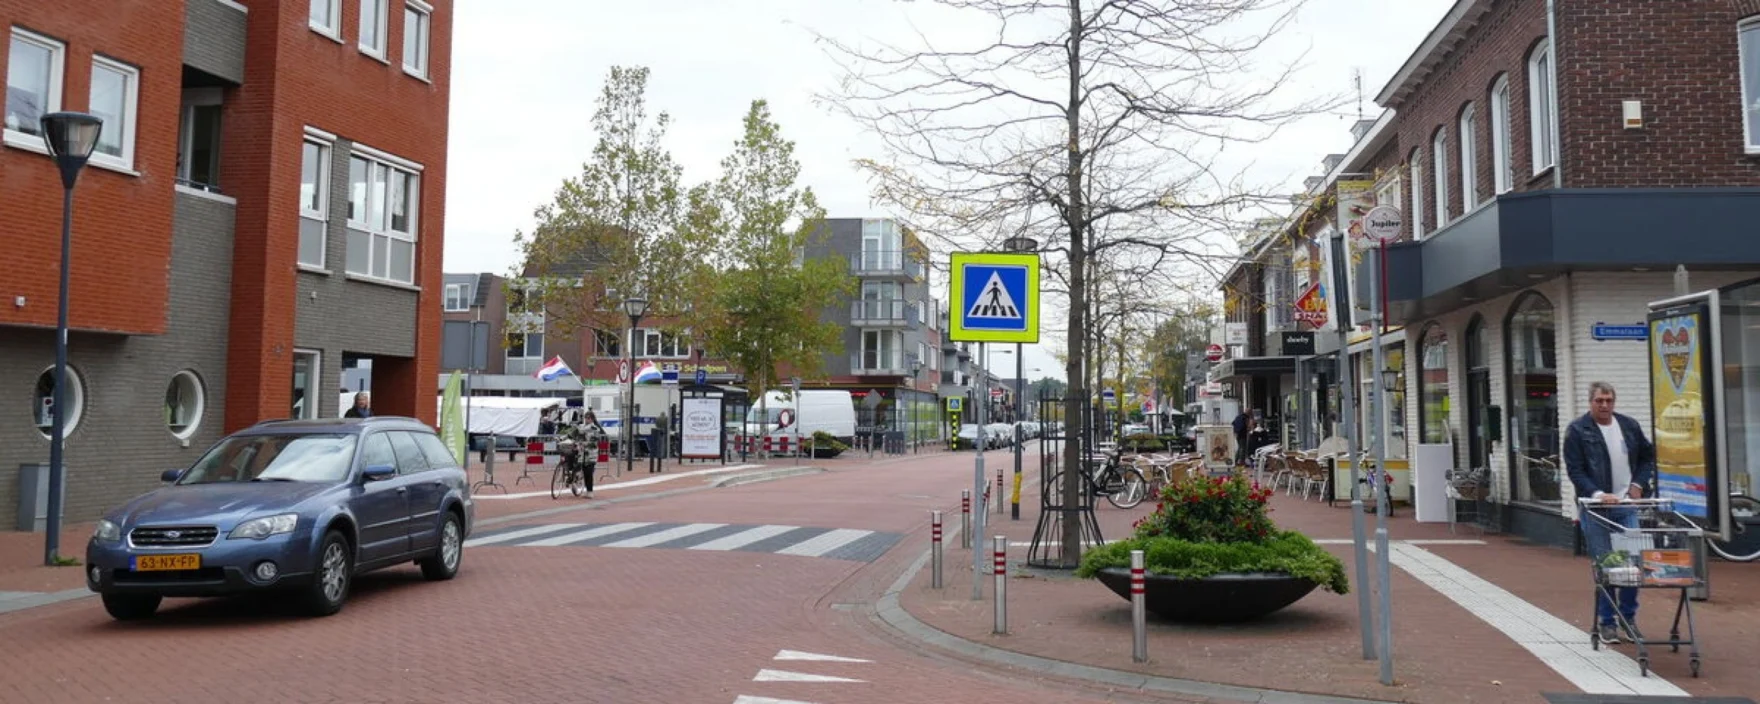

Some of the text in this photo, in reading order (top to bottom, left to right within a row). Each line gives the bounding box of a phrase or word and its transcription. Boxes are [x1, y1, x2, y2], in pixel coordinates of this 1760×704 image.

[1371, 219, 1401, 229] Jupiler
[1600, 328, 1644, 336] Emmalaan
[141, 555, 196, 569] 63-NX-FP
